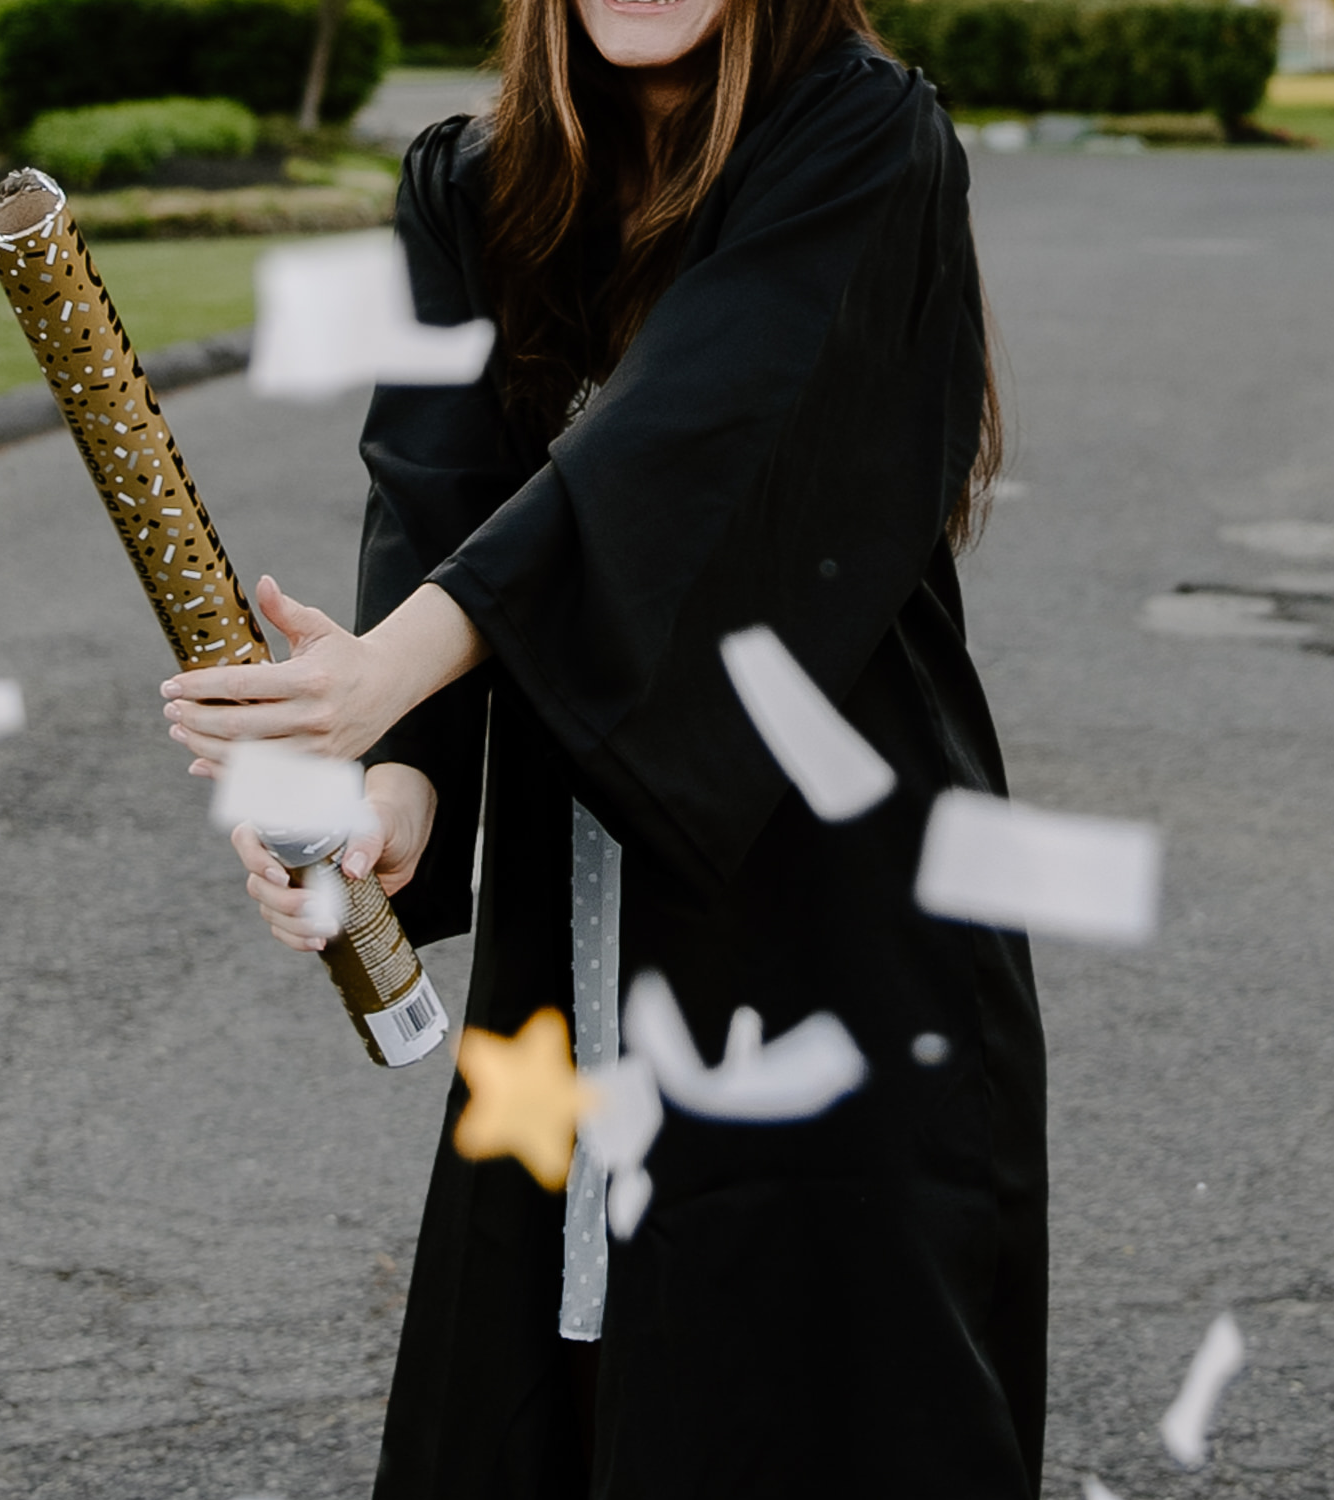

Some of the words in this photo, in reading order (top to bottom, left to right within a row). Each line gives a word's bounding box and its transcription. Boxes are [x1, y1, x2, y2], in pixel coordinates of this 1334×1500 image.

[65, 409, 108, 485] CONFETI
[101, 488, 122, 512] DE
[117, 515, 157, 594] GIGANTE
